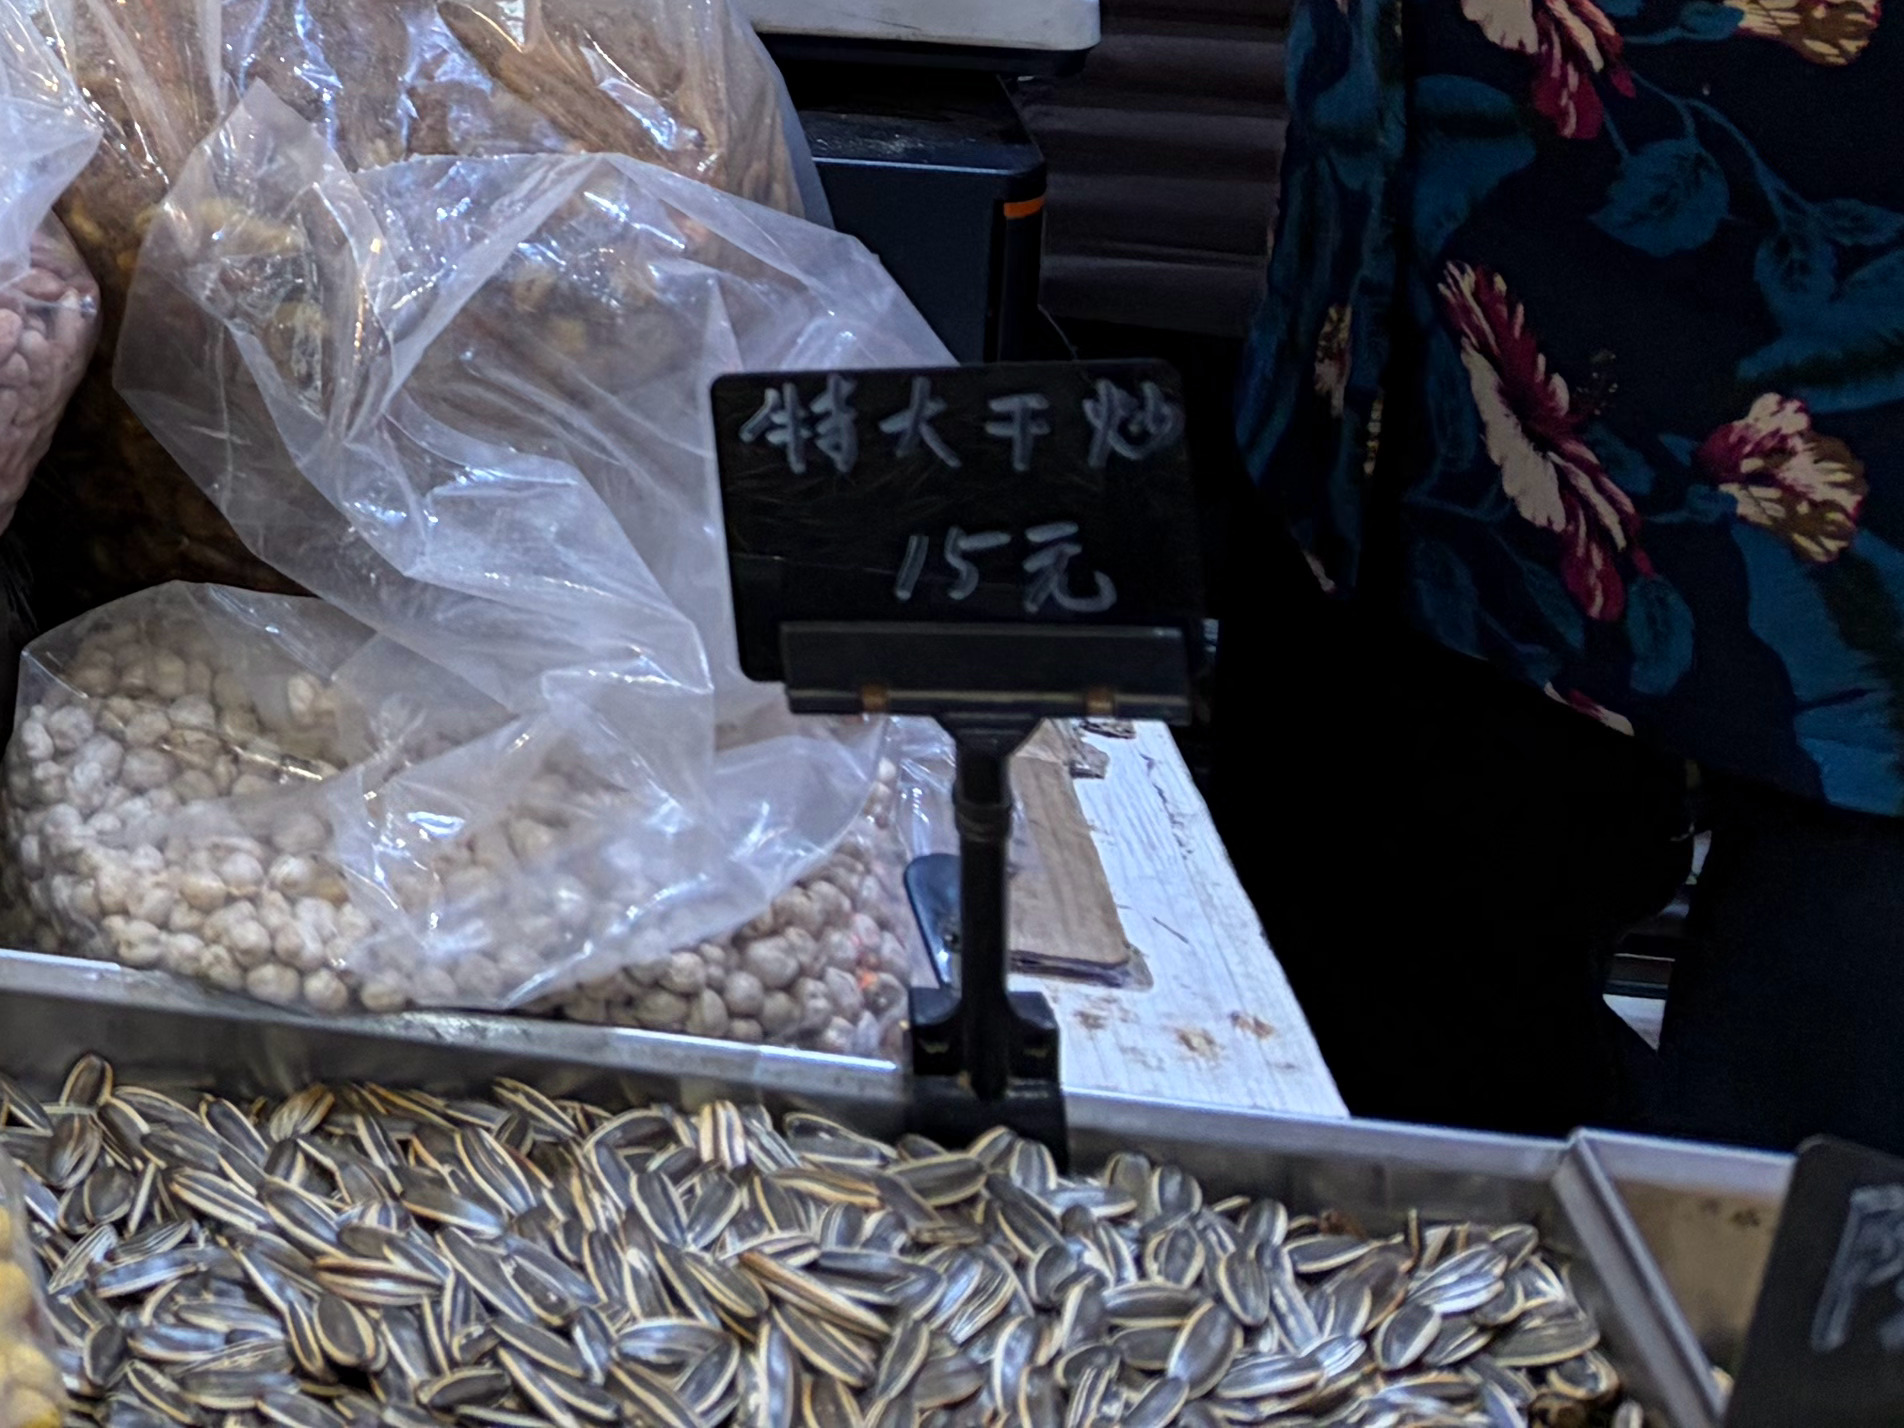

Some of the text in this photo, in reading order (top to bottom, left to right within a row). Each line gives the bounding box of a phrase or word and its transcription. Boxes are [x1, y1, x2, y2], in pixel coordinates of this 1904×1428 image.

[740, 373, 1186, 475] 特大干炒
[895, 520, 1118, 613] 15元
